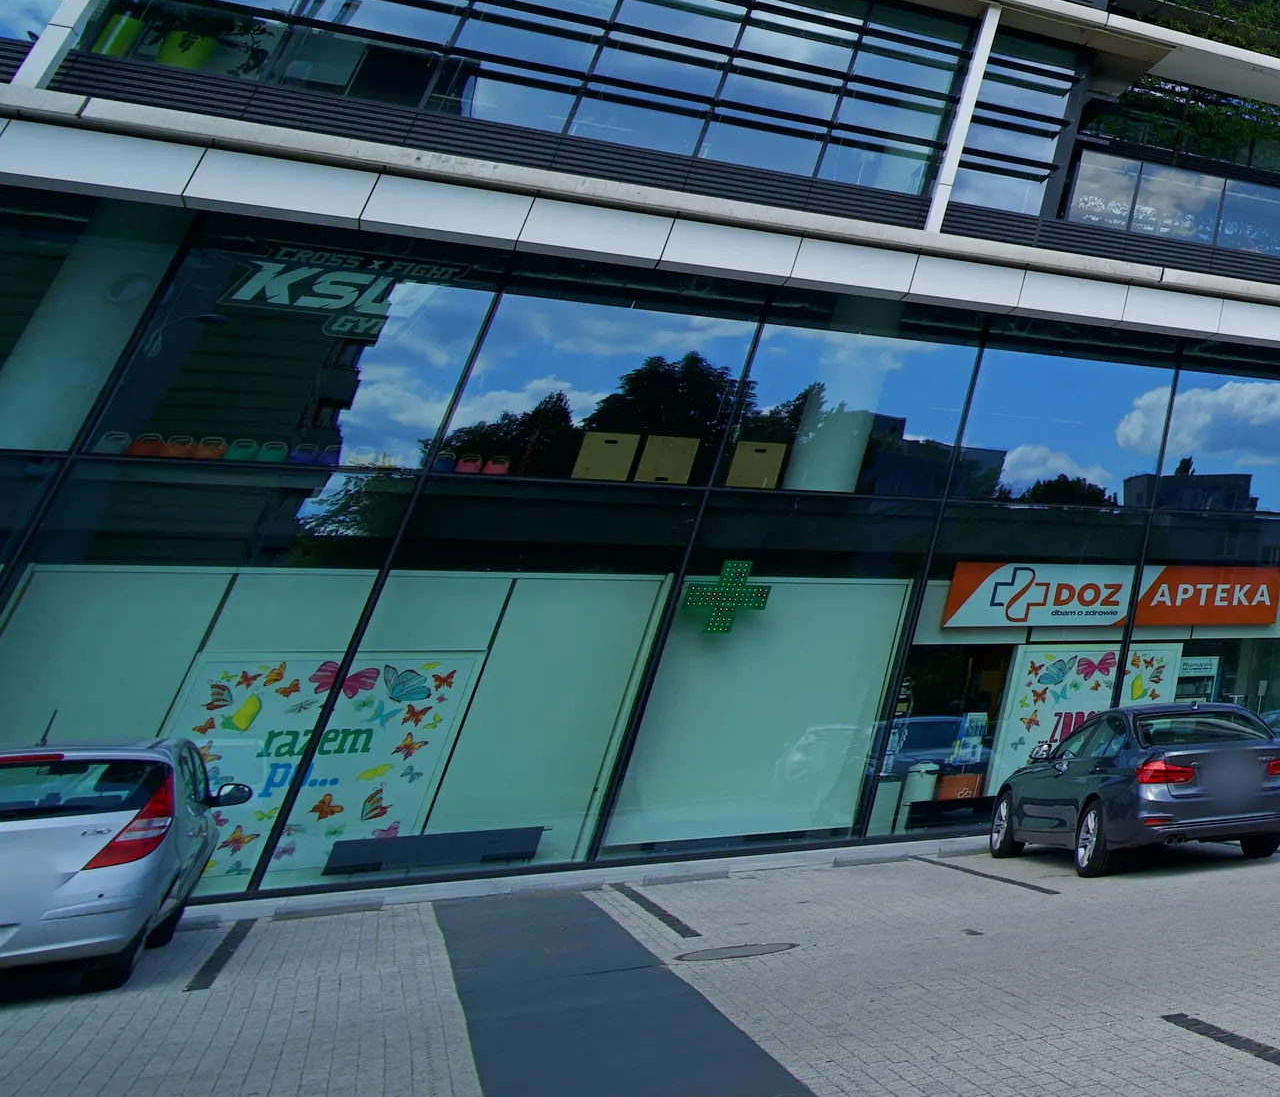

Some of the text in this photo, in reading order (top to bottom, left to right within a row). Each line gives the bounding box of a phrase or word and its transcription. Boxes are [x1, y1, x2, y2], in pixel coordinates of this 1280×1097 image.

[273, 246, 363, 269] CROSS
[389, 260, 461, 279] FIGHT
[1052, 582, 1272, 607] DOZ APTEKA
[1051, 609, 1076, 617] dbam
[1084, 609, 1119, 617] zdrowie
[255, 727, 374, 758] razem
